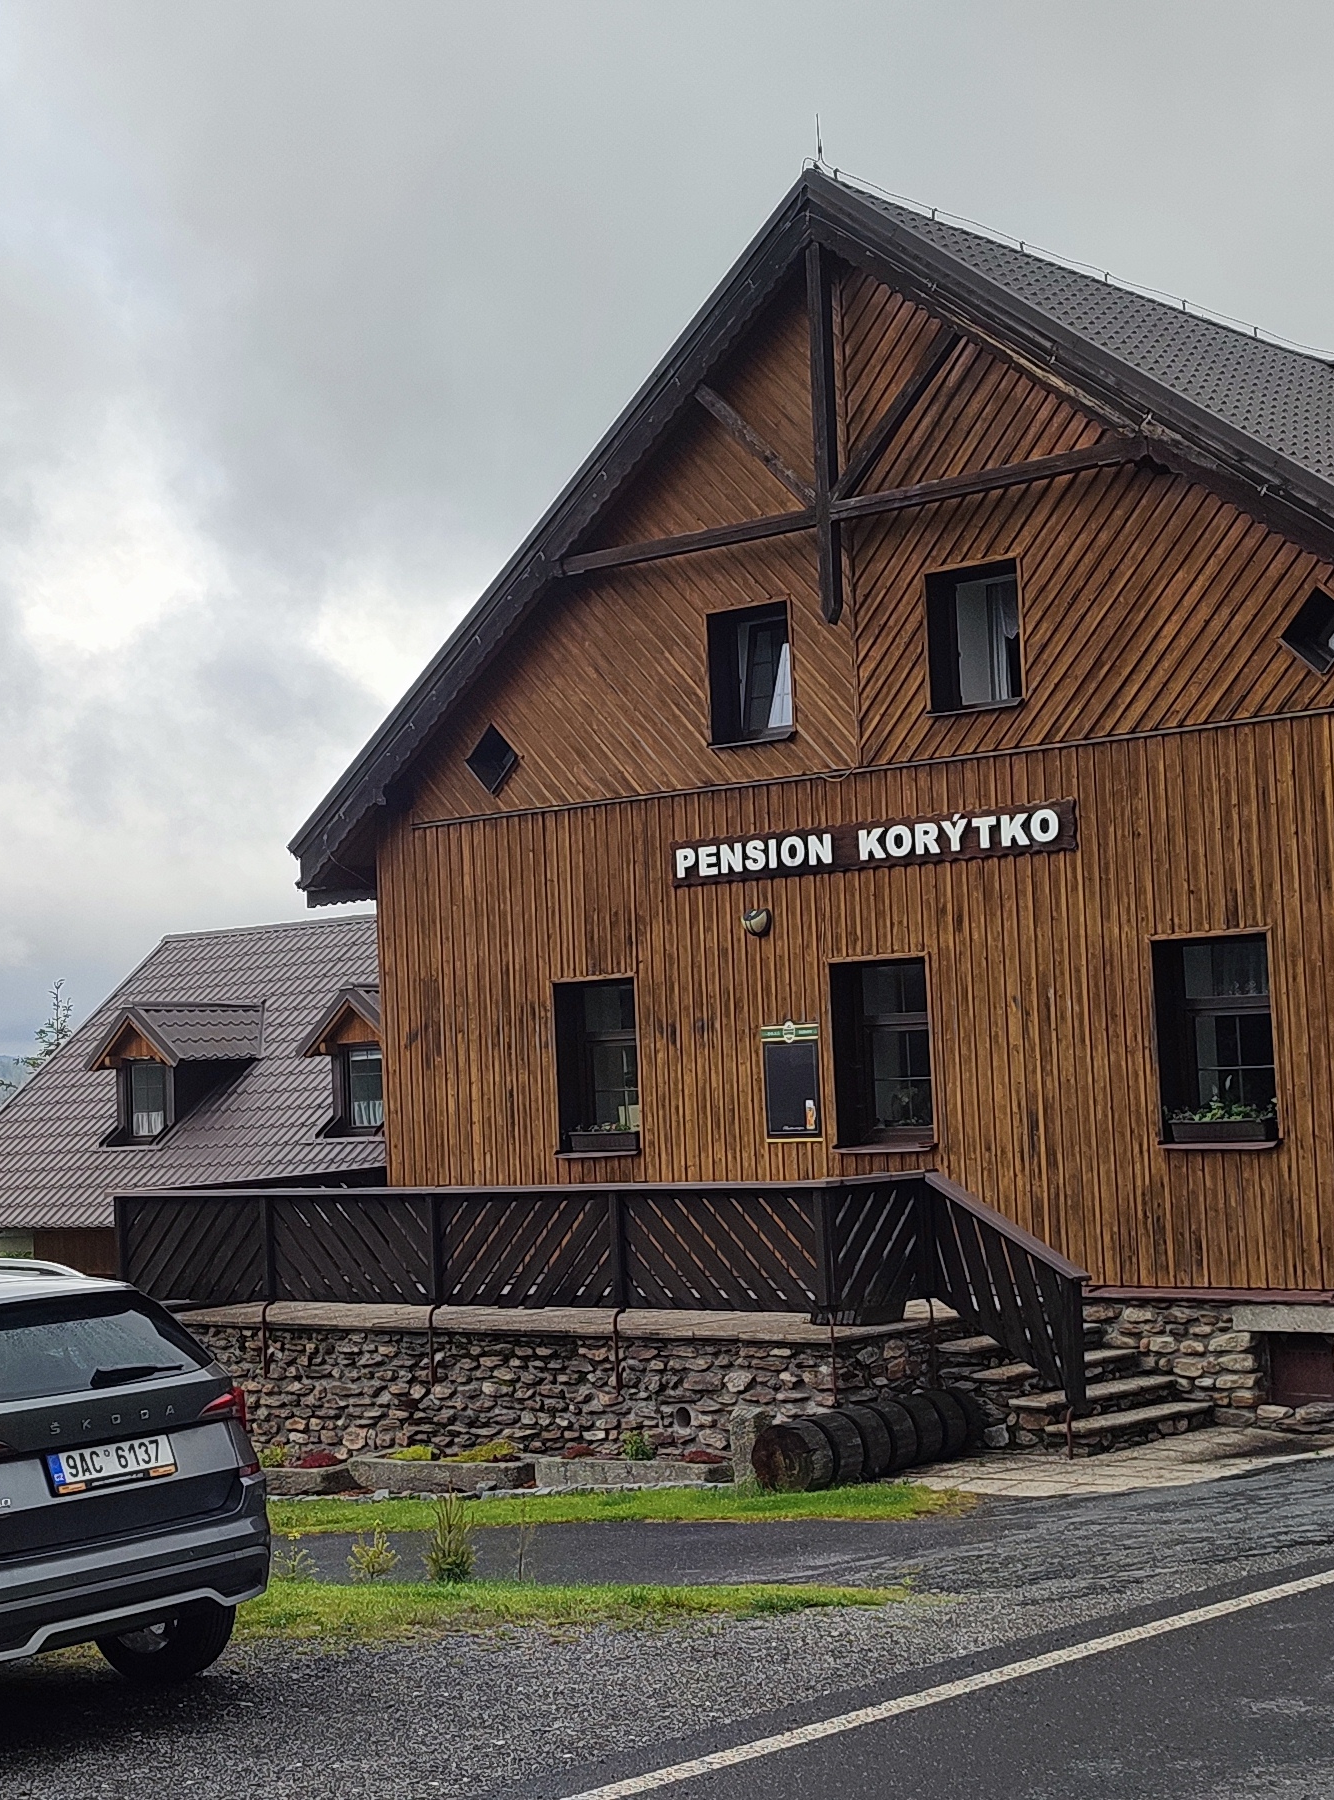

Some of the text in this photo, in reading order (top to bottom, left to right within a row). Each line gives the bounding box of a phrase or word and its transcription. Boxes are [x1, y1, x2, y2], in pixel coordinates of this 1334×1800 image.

[675, 808, 1059, 878] PENSION KORÝTKO
[49, 1404, 175, 1435] ŠKODA
[65, 1439, 160, 1478] 9AC 6137
